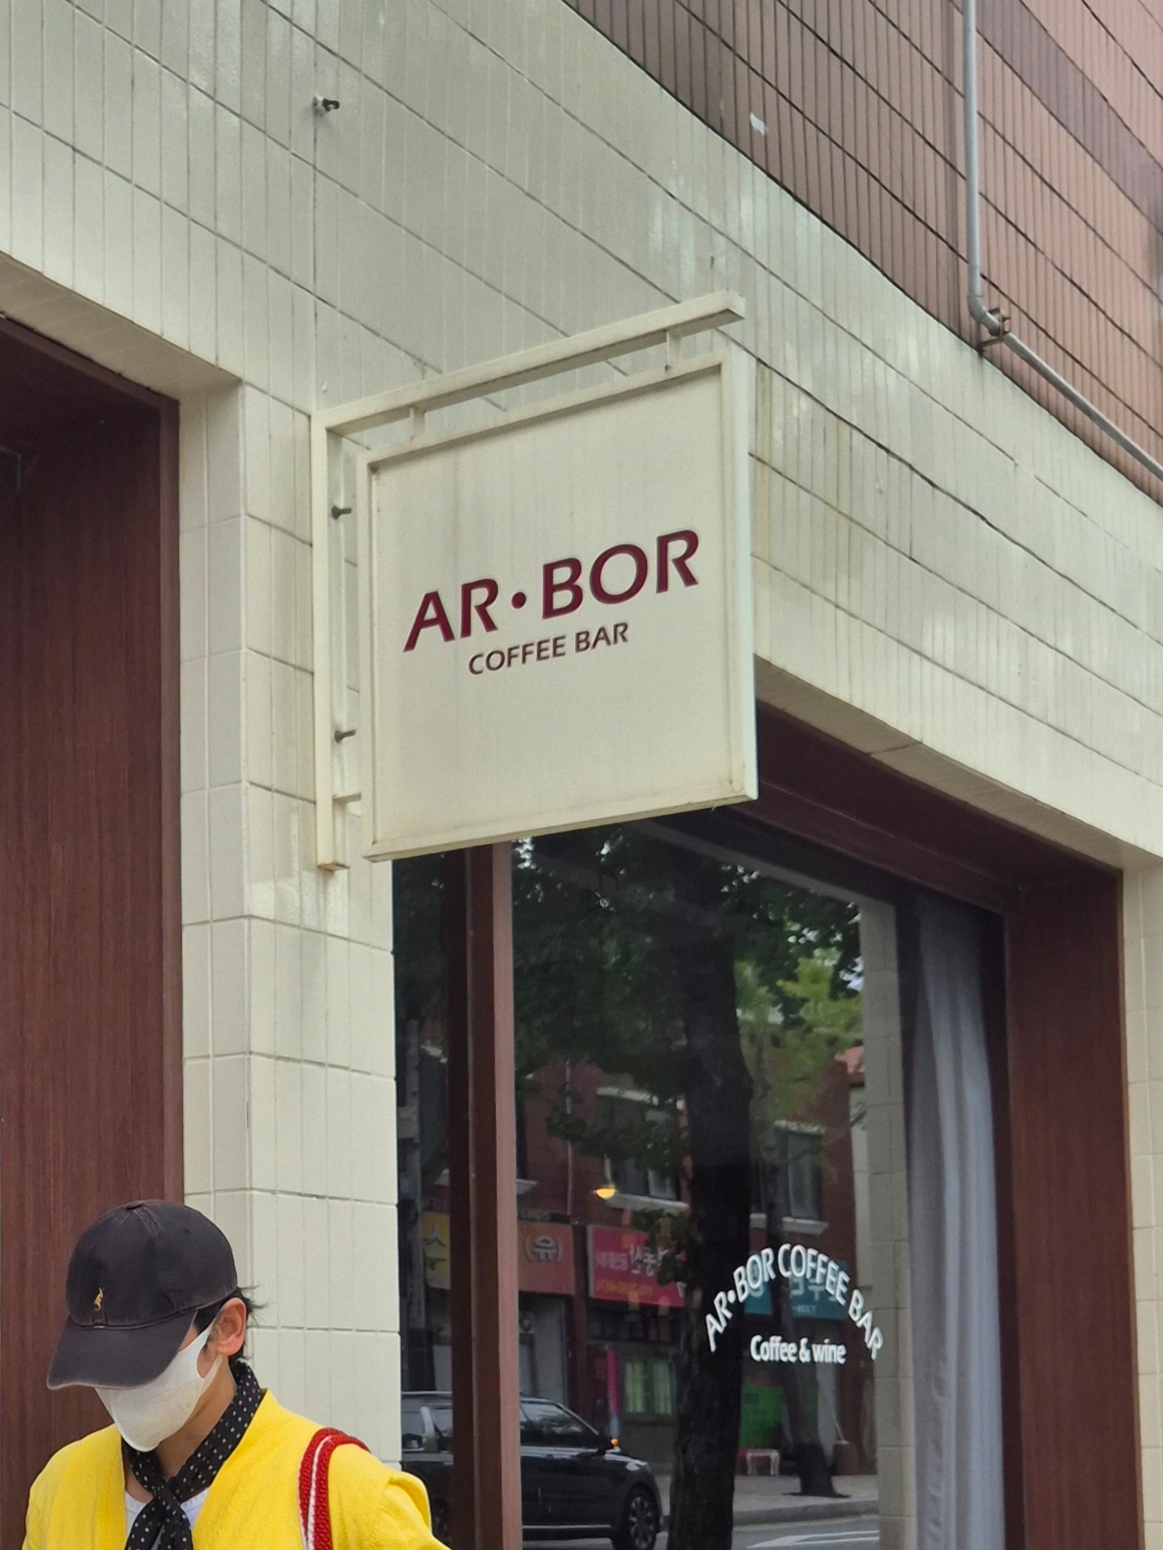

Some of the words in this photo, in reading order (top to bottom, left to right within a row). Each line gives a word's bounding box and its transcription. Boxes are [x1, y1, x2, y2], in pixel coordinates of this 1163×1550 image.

[468, 635, 566, 676] COFFEE
[575, 622, 629, 653] BAR
[778, 1243, 851, 1306] COFFEE
[848, 1289, 883, 1361] BAR
[750, 1334, 797, 1363] Coffee
[798, 1337, 811, 1363] &
[811, 1338, 847, 1364] wine
